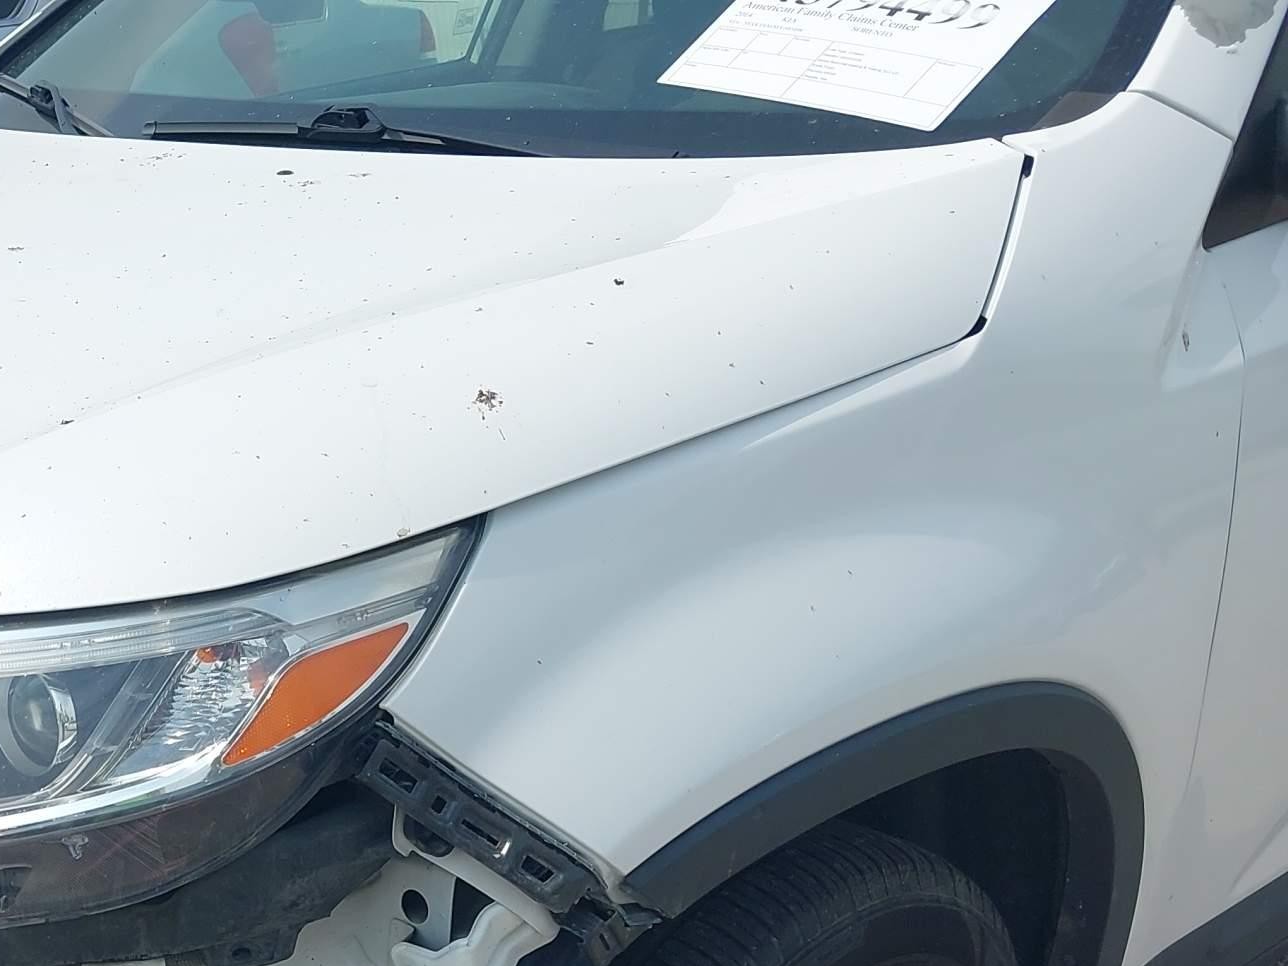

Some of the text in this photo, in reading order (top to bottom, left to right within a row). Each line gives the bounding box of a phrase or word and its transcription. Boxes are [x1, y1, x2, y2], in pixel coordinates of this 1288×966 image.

[742, 1, 920, 32] American Family Claims Center
